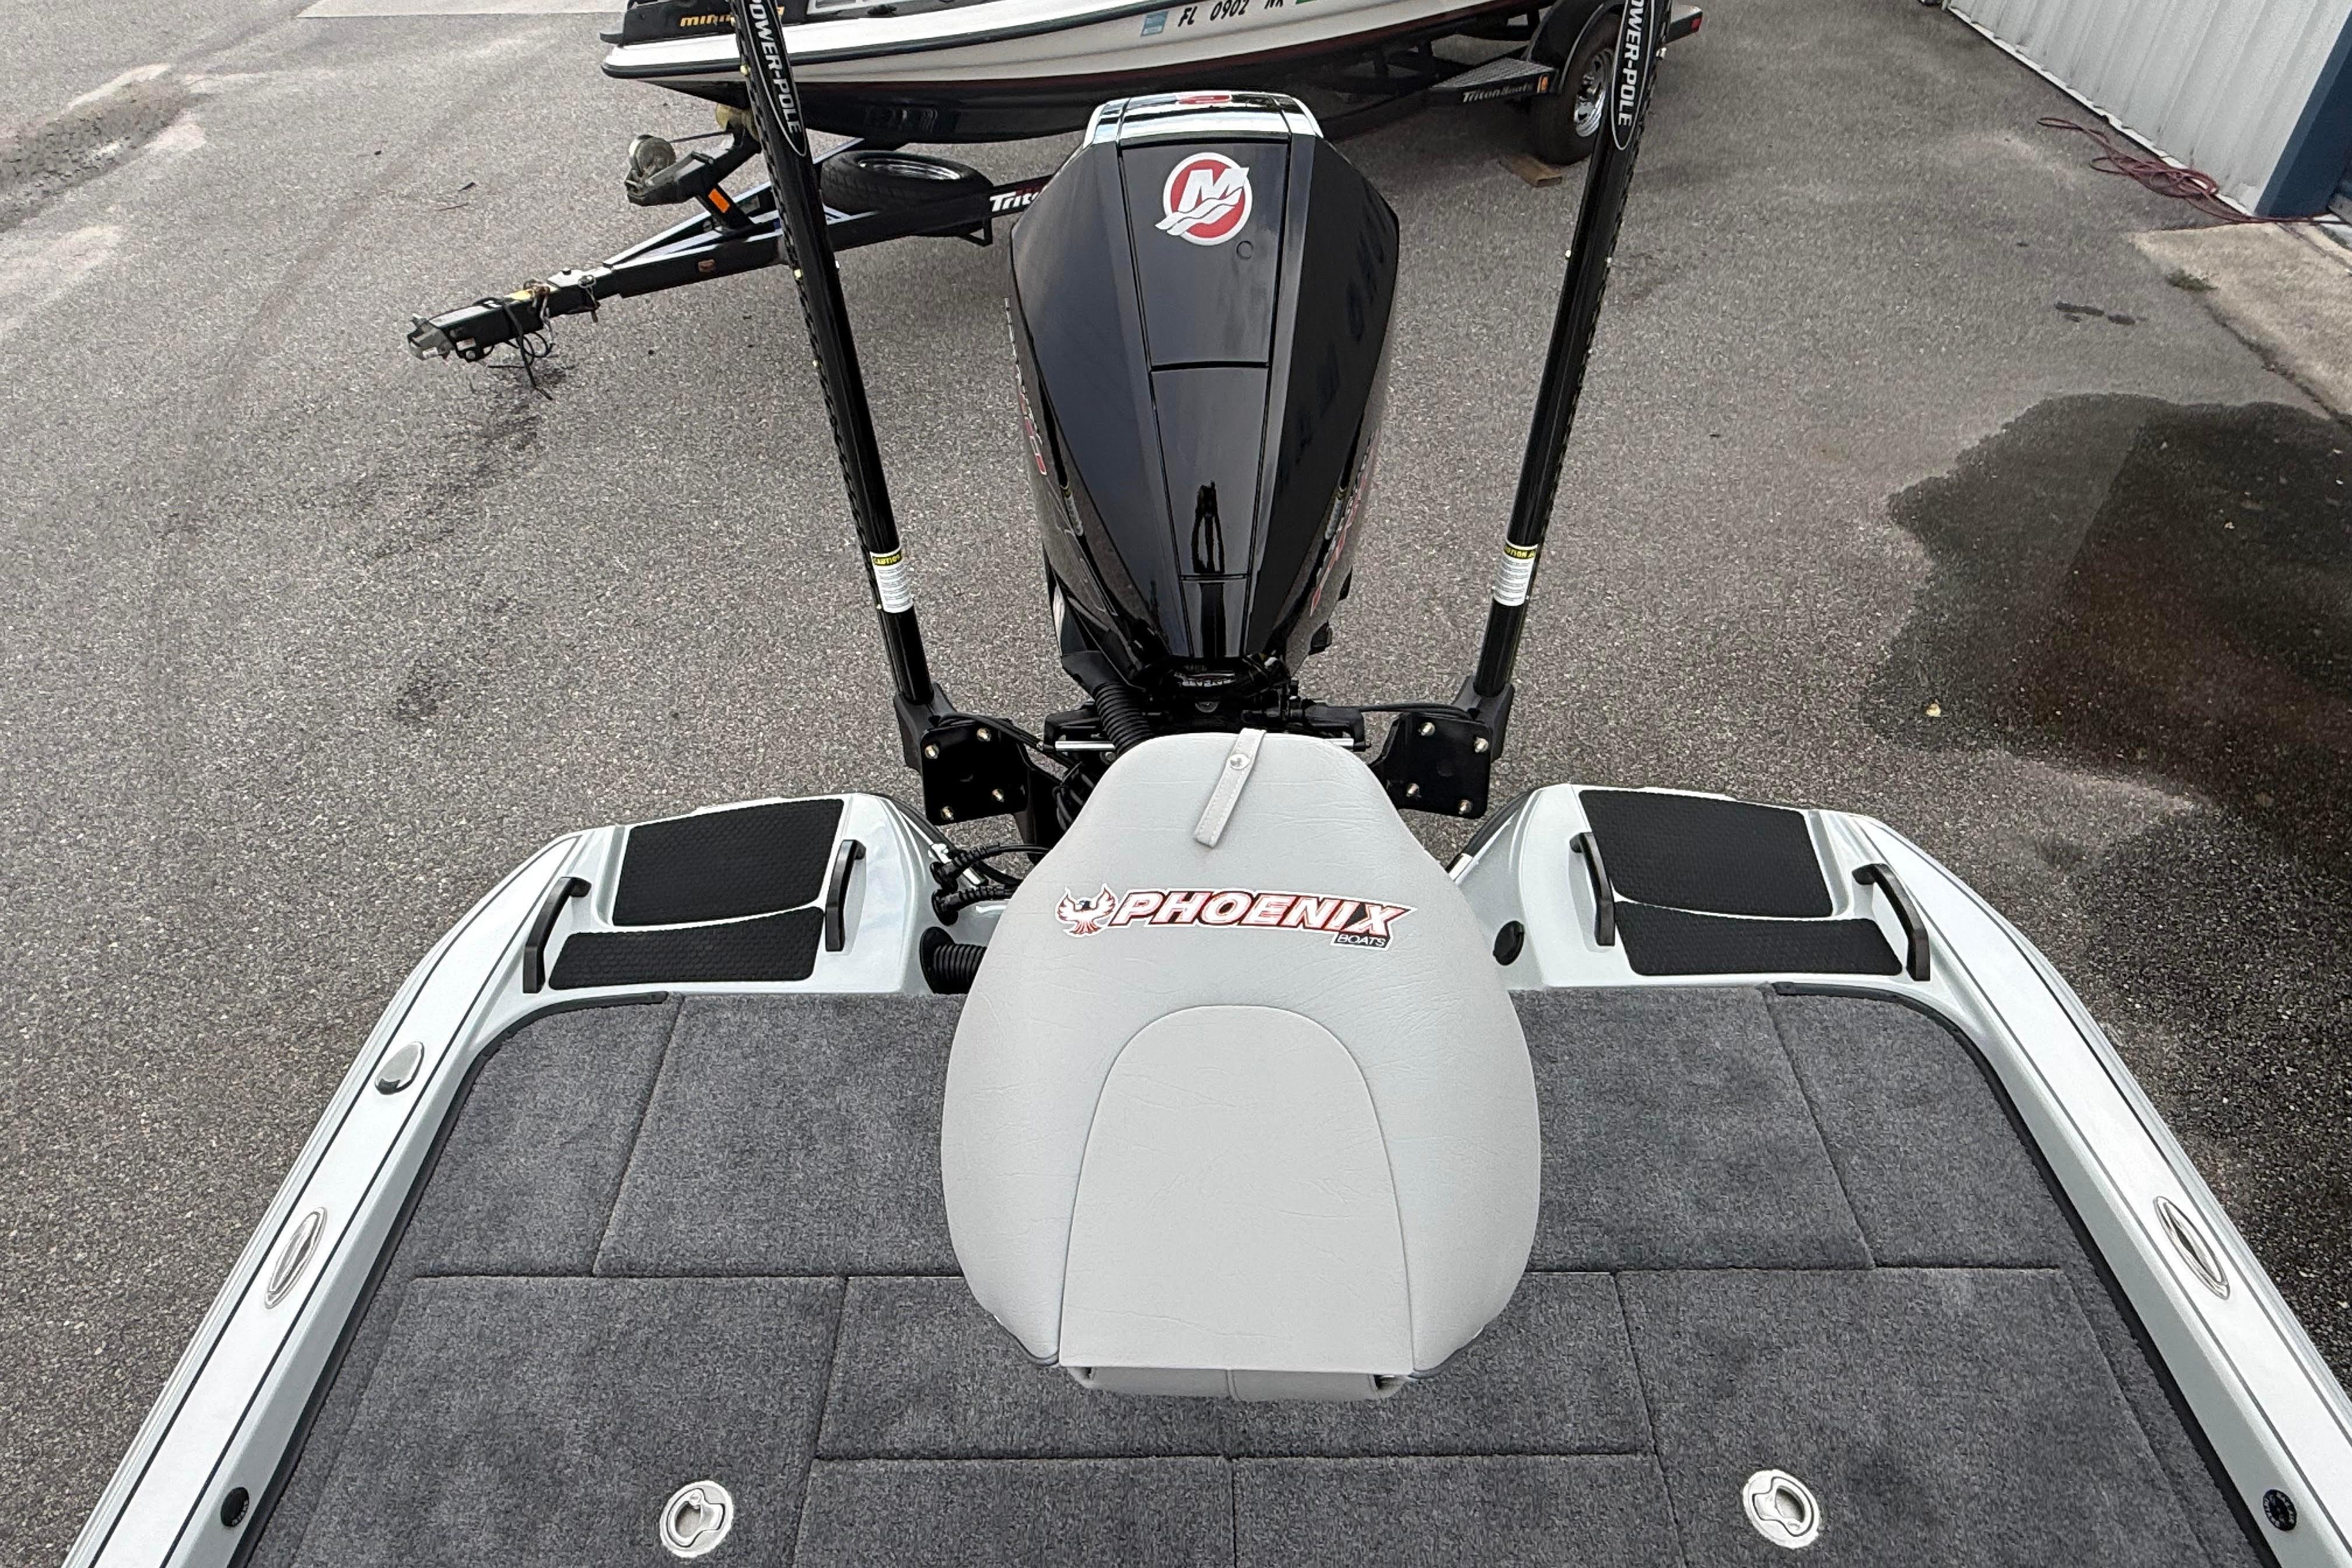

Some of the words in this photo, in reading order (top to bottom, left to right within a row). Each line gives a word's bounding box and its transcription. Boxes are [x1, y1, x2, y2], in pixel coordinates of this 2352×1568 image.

[1178, 6, 1198, 27] FL
[1210, 0, 1248, 21] 0902
[750, 0, 802, 134] OWER-POLE
[989, 191, 1040, 212] Trit
[1109, 891, 1412, 937] PHOENIX
[1337, 933, 1386, 947] BOATS
